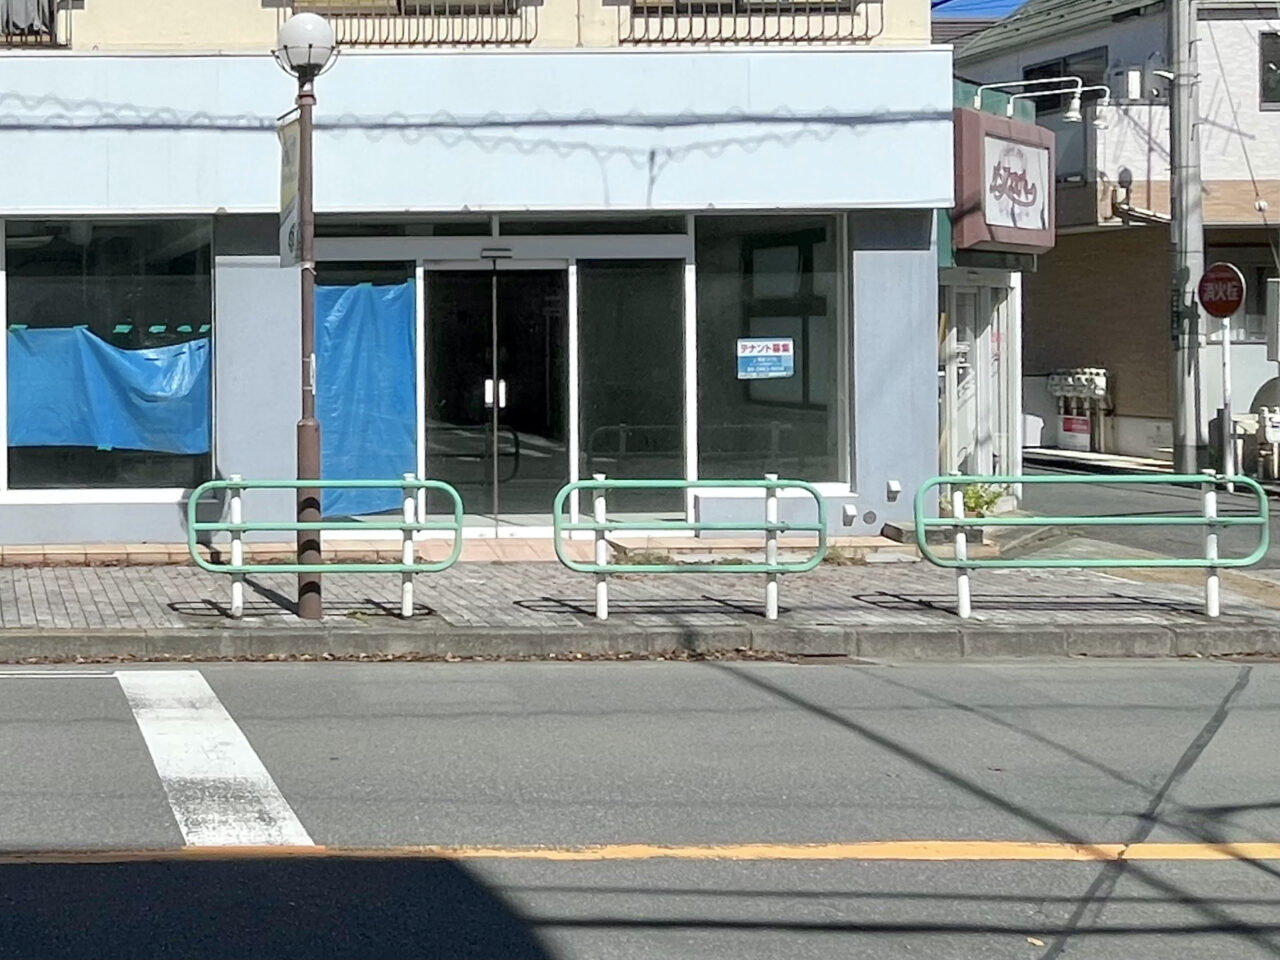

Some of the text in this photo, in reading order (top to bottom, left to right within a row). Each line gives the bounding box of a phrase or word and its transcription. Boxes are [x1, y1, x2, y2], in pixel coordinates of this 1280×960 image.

[1202, 281, 1240, 301] 消火栓
[740, 343, 790, 354] テナント募集
